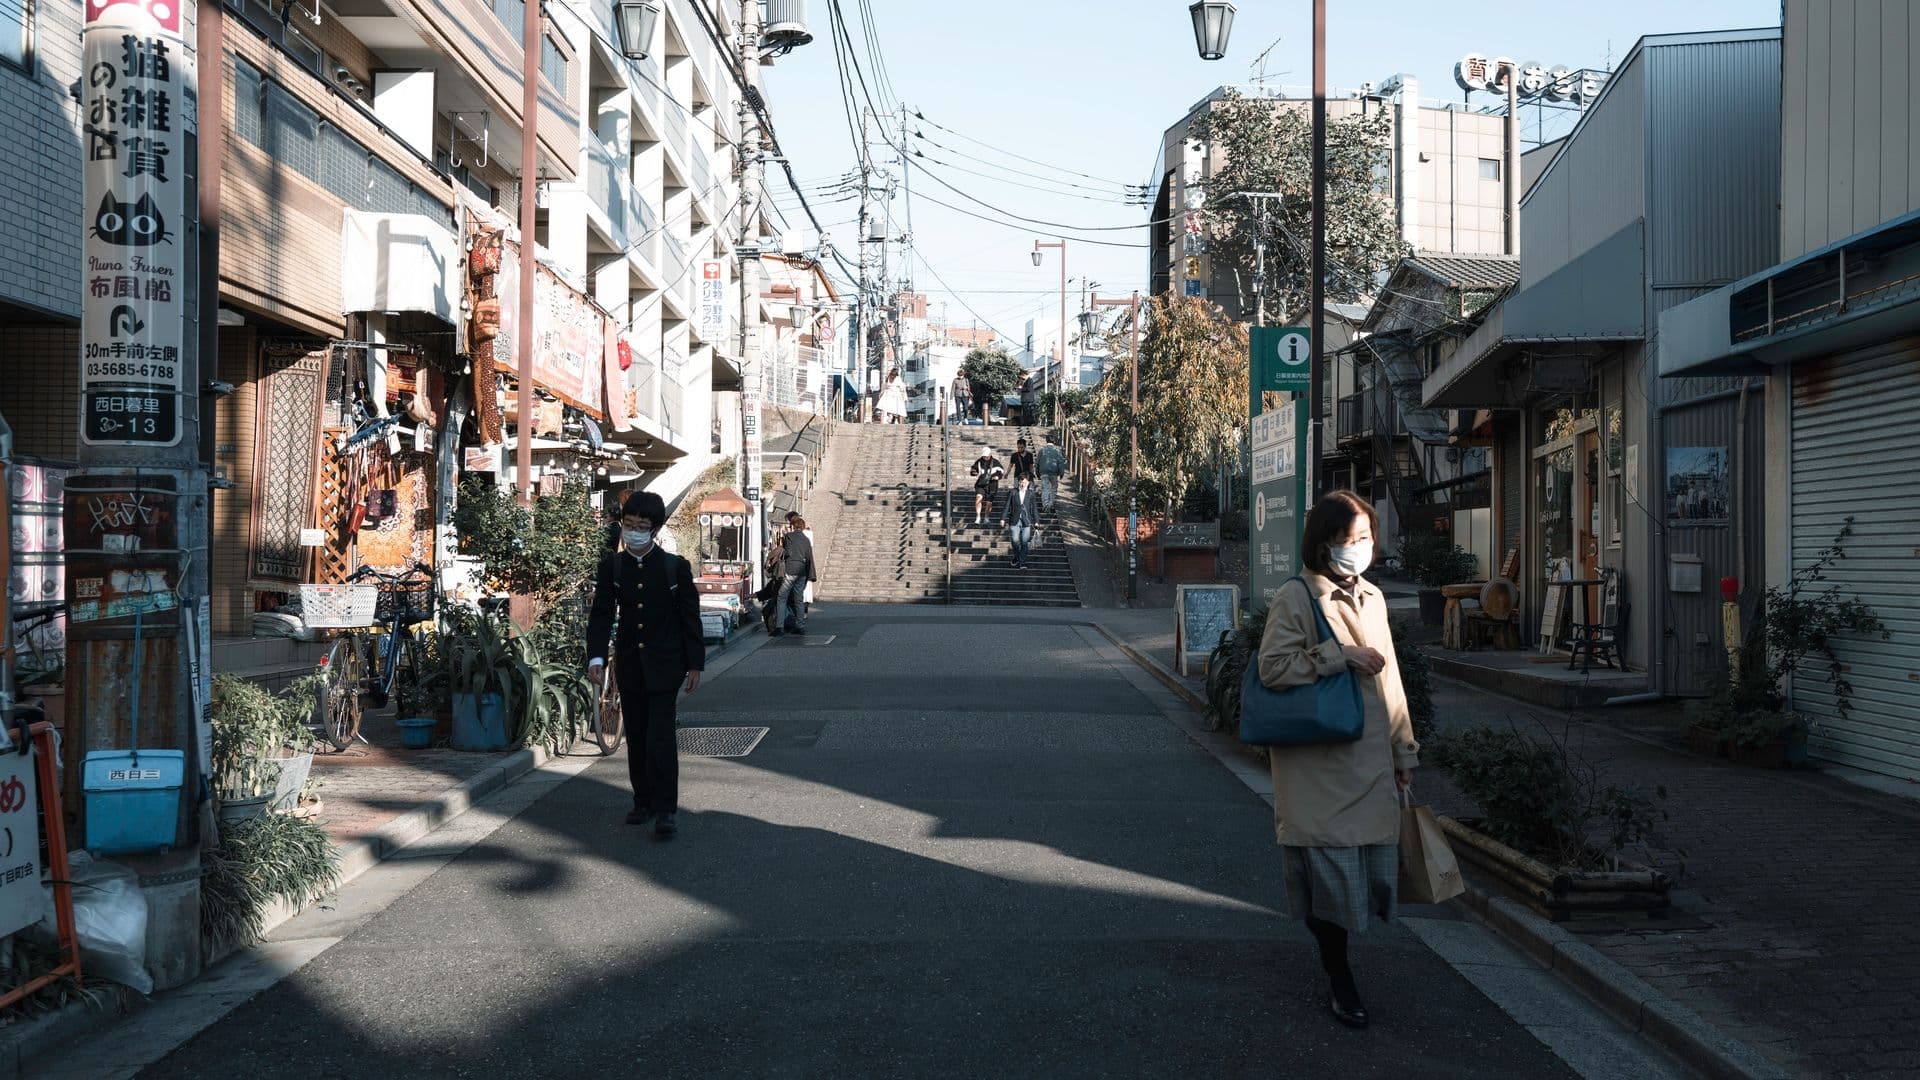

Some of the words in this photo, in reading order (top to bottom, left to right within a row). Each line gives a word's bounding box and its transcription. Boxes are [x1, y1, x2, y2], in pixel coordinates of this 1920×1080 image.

[121, 34, 170, 183] 猫雑貨
[130, 255, 174, 277] Fusen
[90, 275, 171, 303] 布風船
[702, 280, 712, 324] クリニック
[85, 342, 178, 363] 30m手前左側
[87, 362, 174, 379] 03-5685-6788
[95, 396, 160, 414] 西日暮里
[110, 769, 159, 780] 西日三
